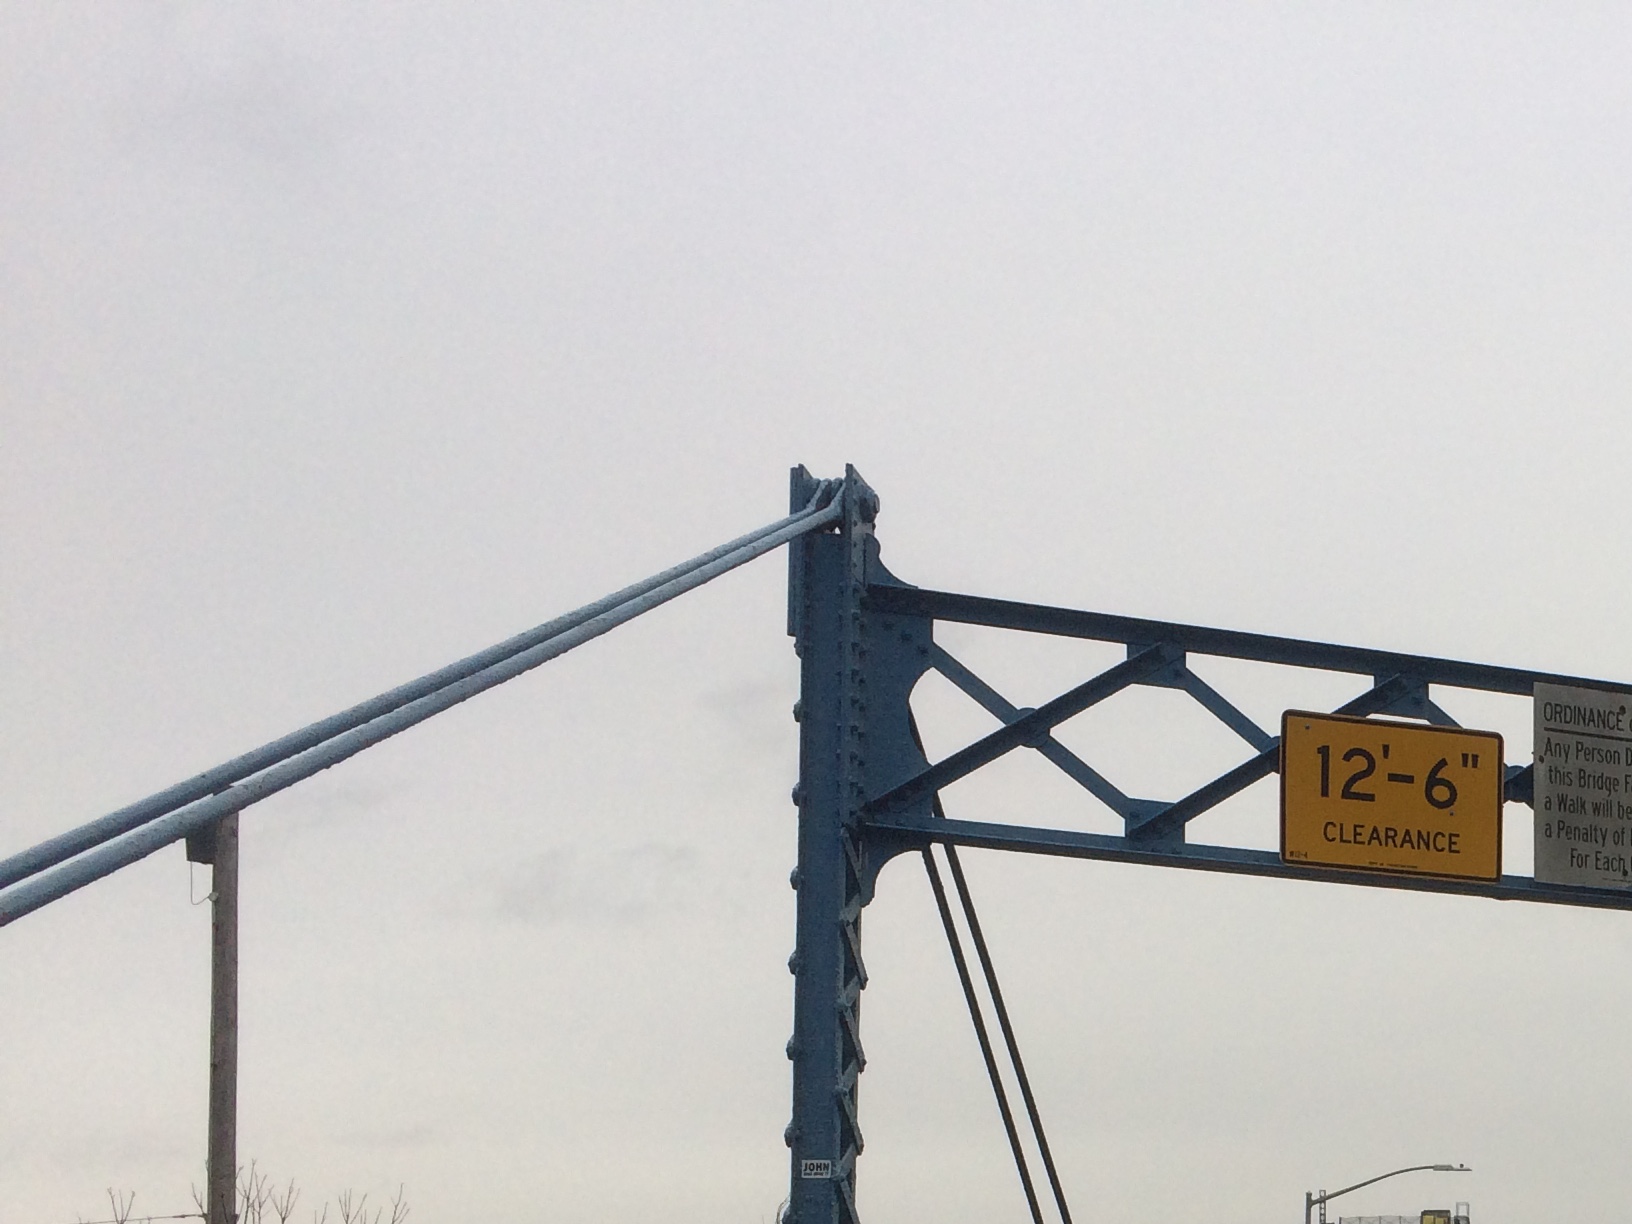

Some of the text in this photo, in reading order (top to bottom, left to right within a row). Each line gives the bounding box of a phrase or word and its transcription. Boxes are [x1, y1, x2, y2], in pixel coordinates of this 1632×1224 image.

[1543, 702, 1625, 732] ORDINANCE
[1543, 737, 1571, 763] Any
[1575, 741, 1621, 765] Person
[1548, 765, 1573, 787] this
[1578, 768, 1620, 797] Bridge
[1544, 795, 1552, 811] a
[1556, 793, 1587, 815] Walk
[1591, 799, 1613, 819] will
[1617, 801, 1632, 820] be
[1323, 821, 1461, 854] CLEARANCE
[1544, 822, 1553, 838] a
[1557, 820, 1608, 847] Penalty
[1612, 827, 1625, 847] of
[1570, 848, 1590, 869] For
[1595, 851, 1626, 872] Each
[803, 1162, 830, 1172] JOHN
